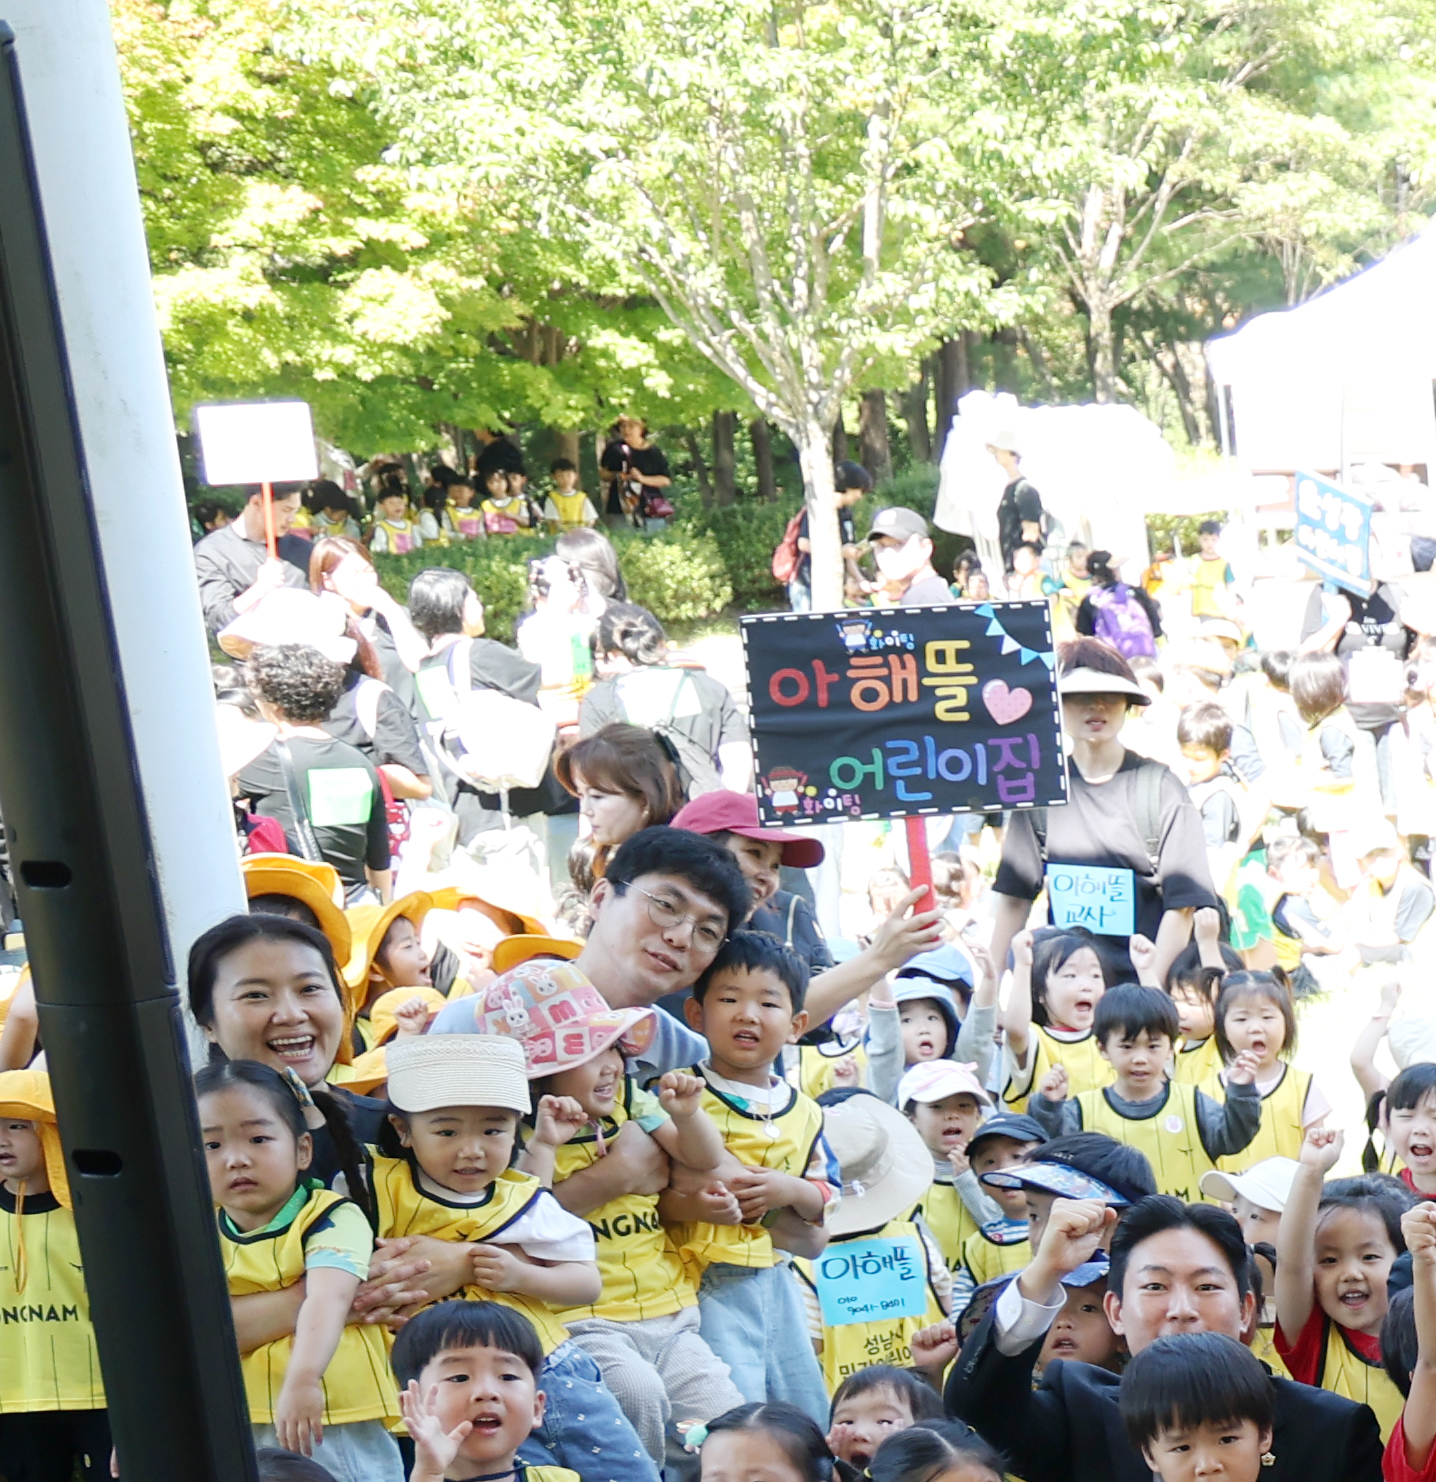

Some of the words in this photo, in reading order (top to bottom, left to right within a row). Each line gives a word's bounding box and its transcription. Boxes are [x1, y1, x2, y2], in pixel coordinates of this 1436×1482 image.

[768, 640, 978, 722] 아해뜰
[829, 733, 1041, 802] 어린이집
[802, 794, 861, 816] 화이팅
[821, 1246, 917, 1281] 아해뜰
[0, 1303, 79, 1322] NGNAM
